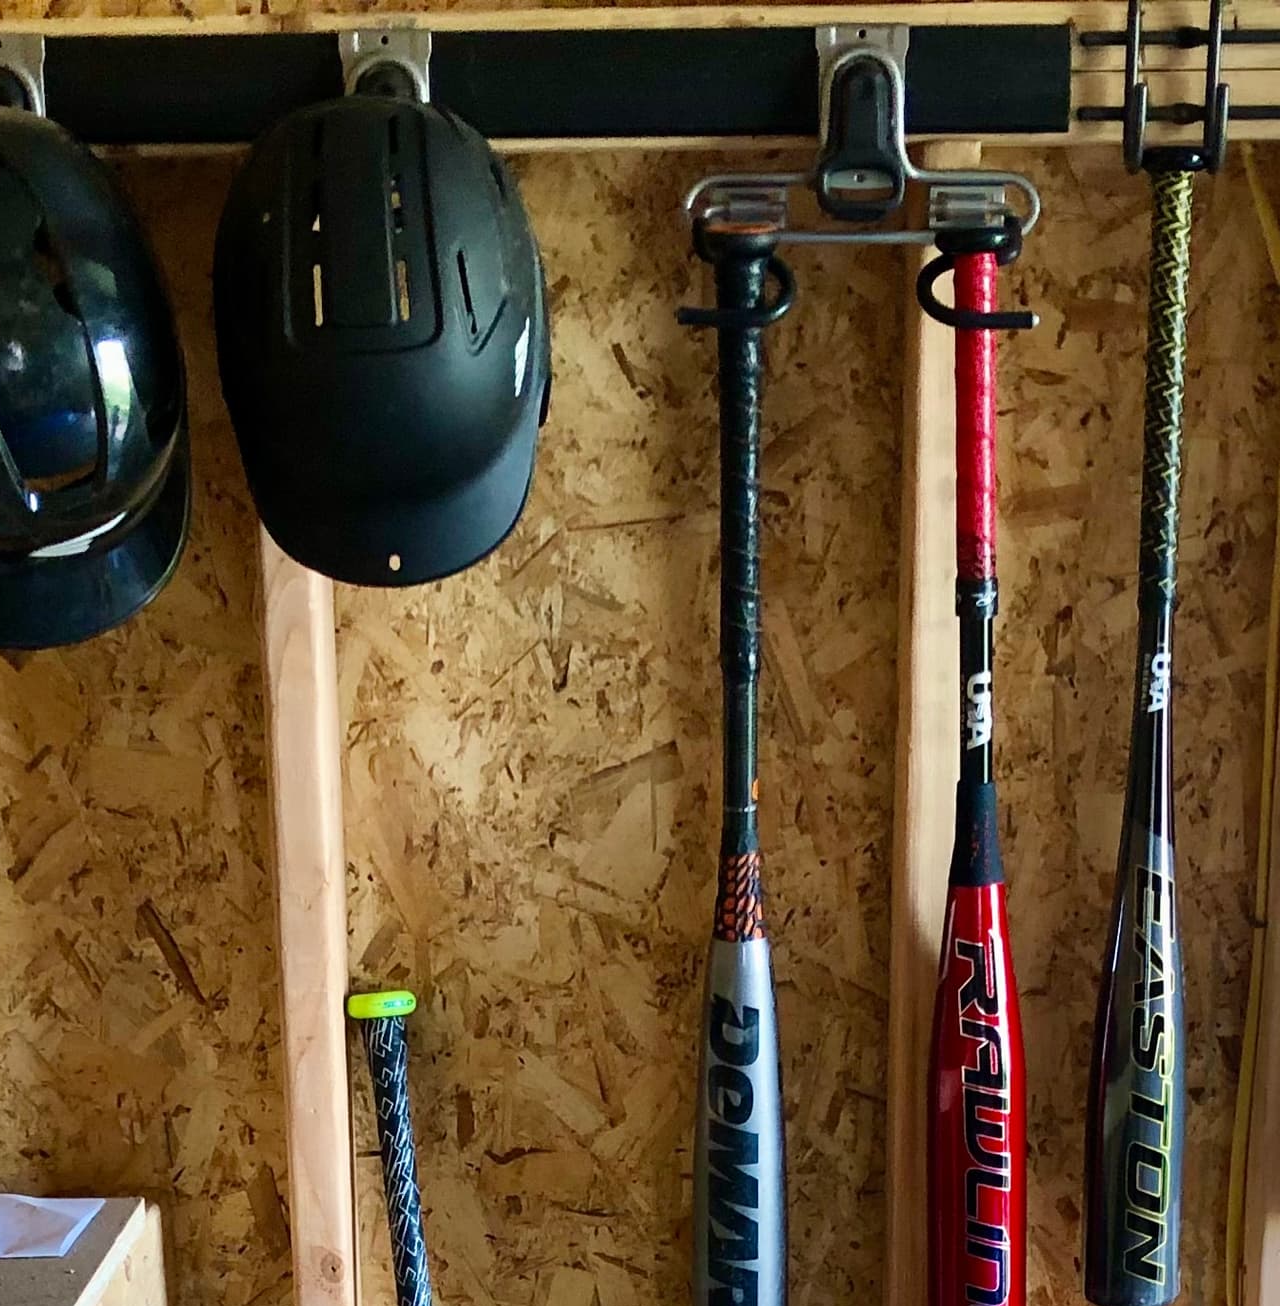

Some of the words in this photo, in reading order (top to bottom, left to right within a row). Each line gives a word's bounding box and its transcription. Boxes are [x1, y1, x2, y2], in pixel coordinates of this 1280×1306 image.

[966, 670, 993, 751] USA
[1147, 652, 1172, 713] USA
[1121, 865, 1177, 1286] EASTON
